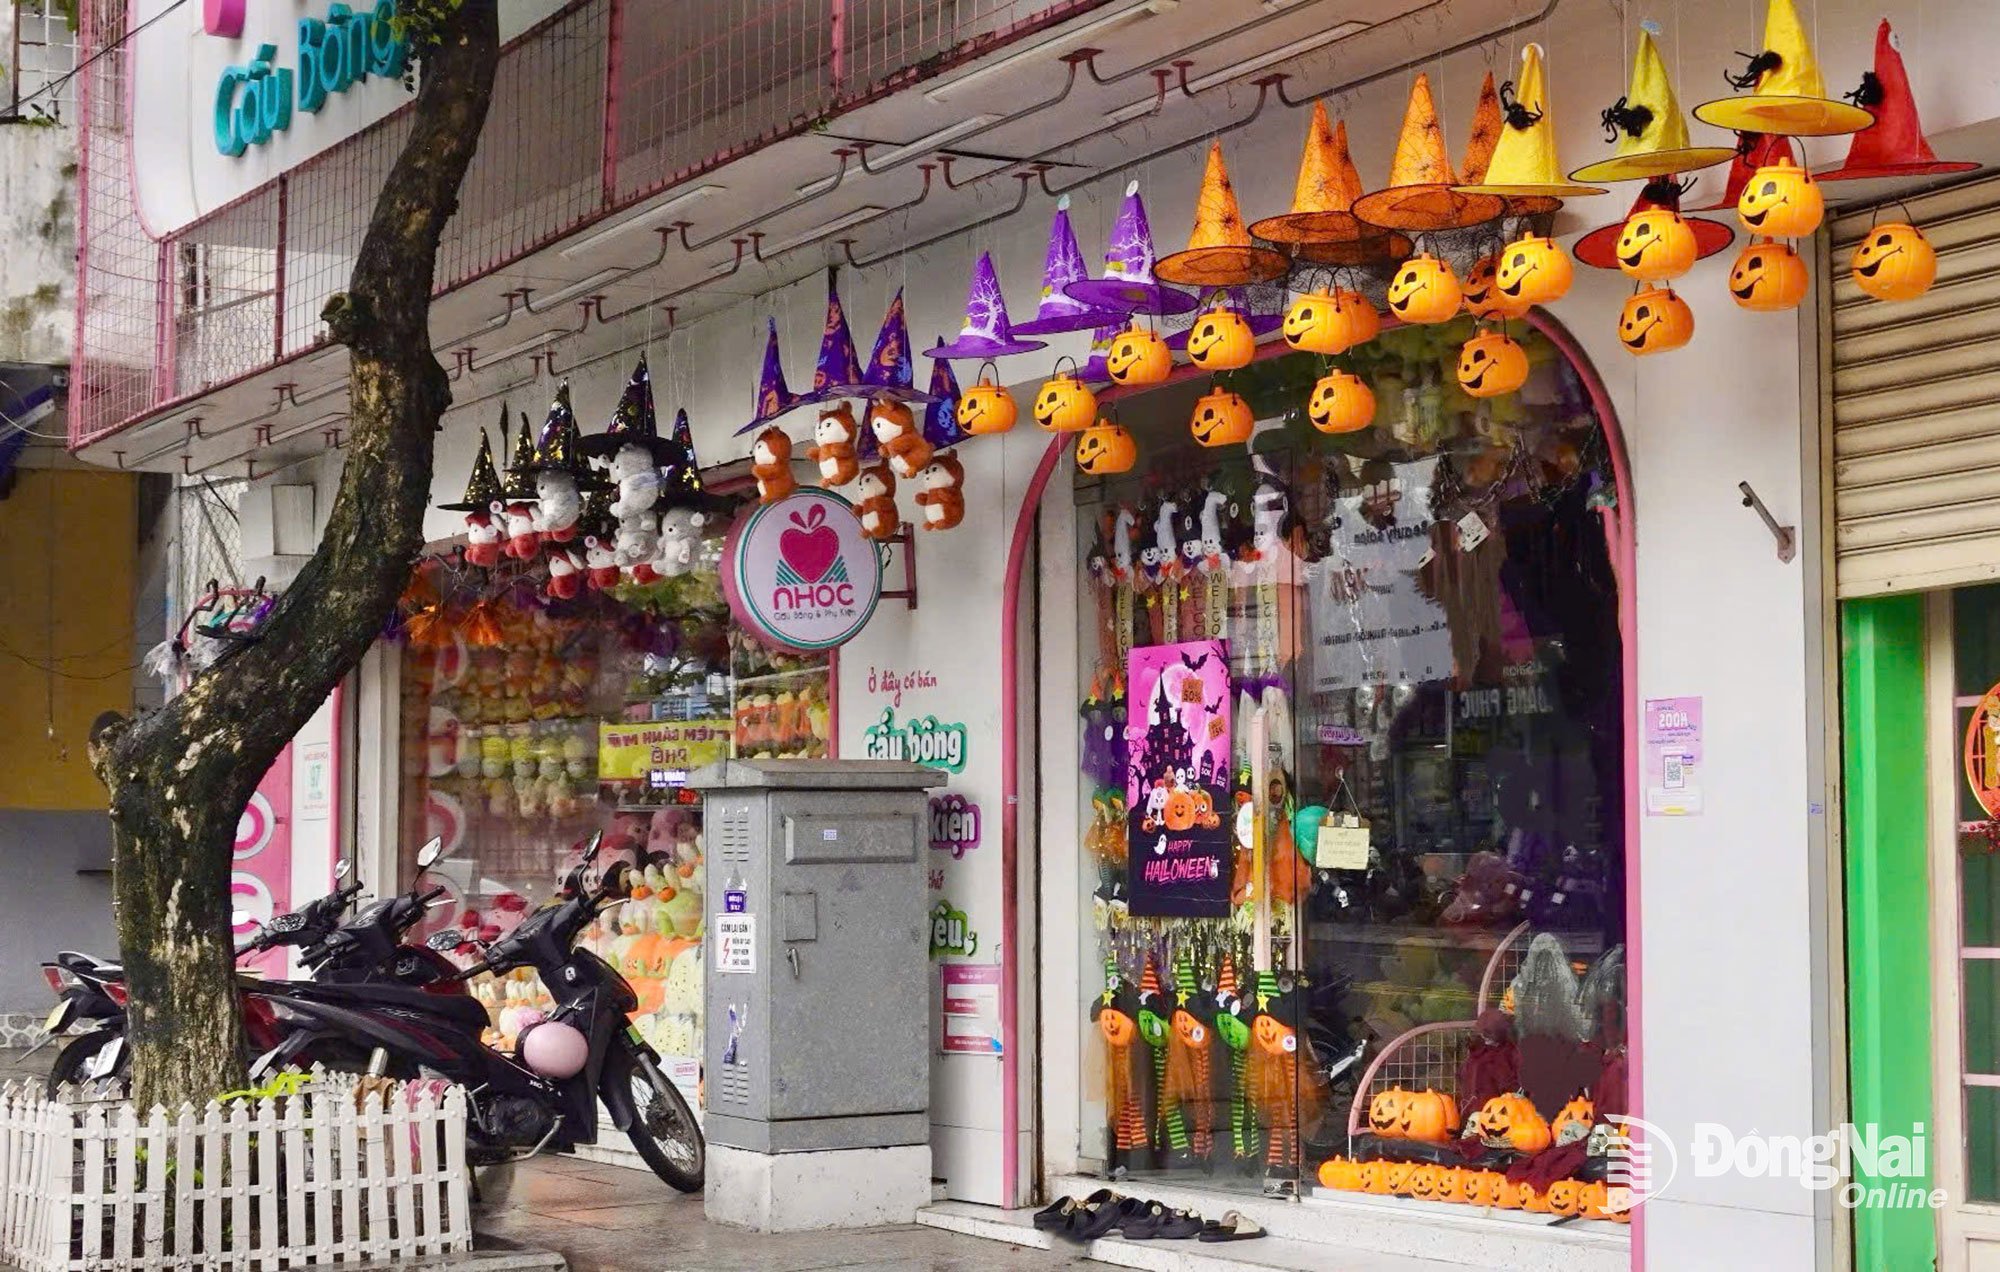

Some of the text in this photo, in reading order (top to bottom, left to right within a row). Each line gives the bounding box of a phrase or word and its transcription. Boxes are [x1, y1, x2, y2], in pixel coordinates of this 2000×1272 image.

[868, 667, 937, 708] Ở đây có bán
[908, 719, 961, 766] bông
[1168, 840, 1193, 853] HAPPY
[1145, 855, 1212, 883] HALLOWEEN
[930, 905, 962, 947] êu
